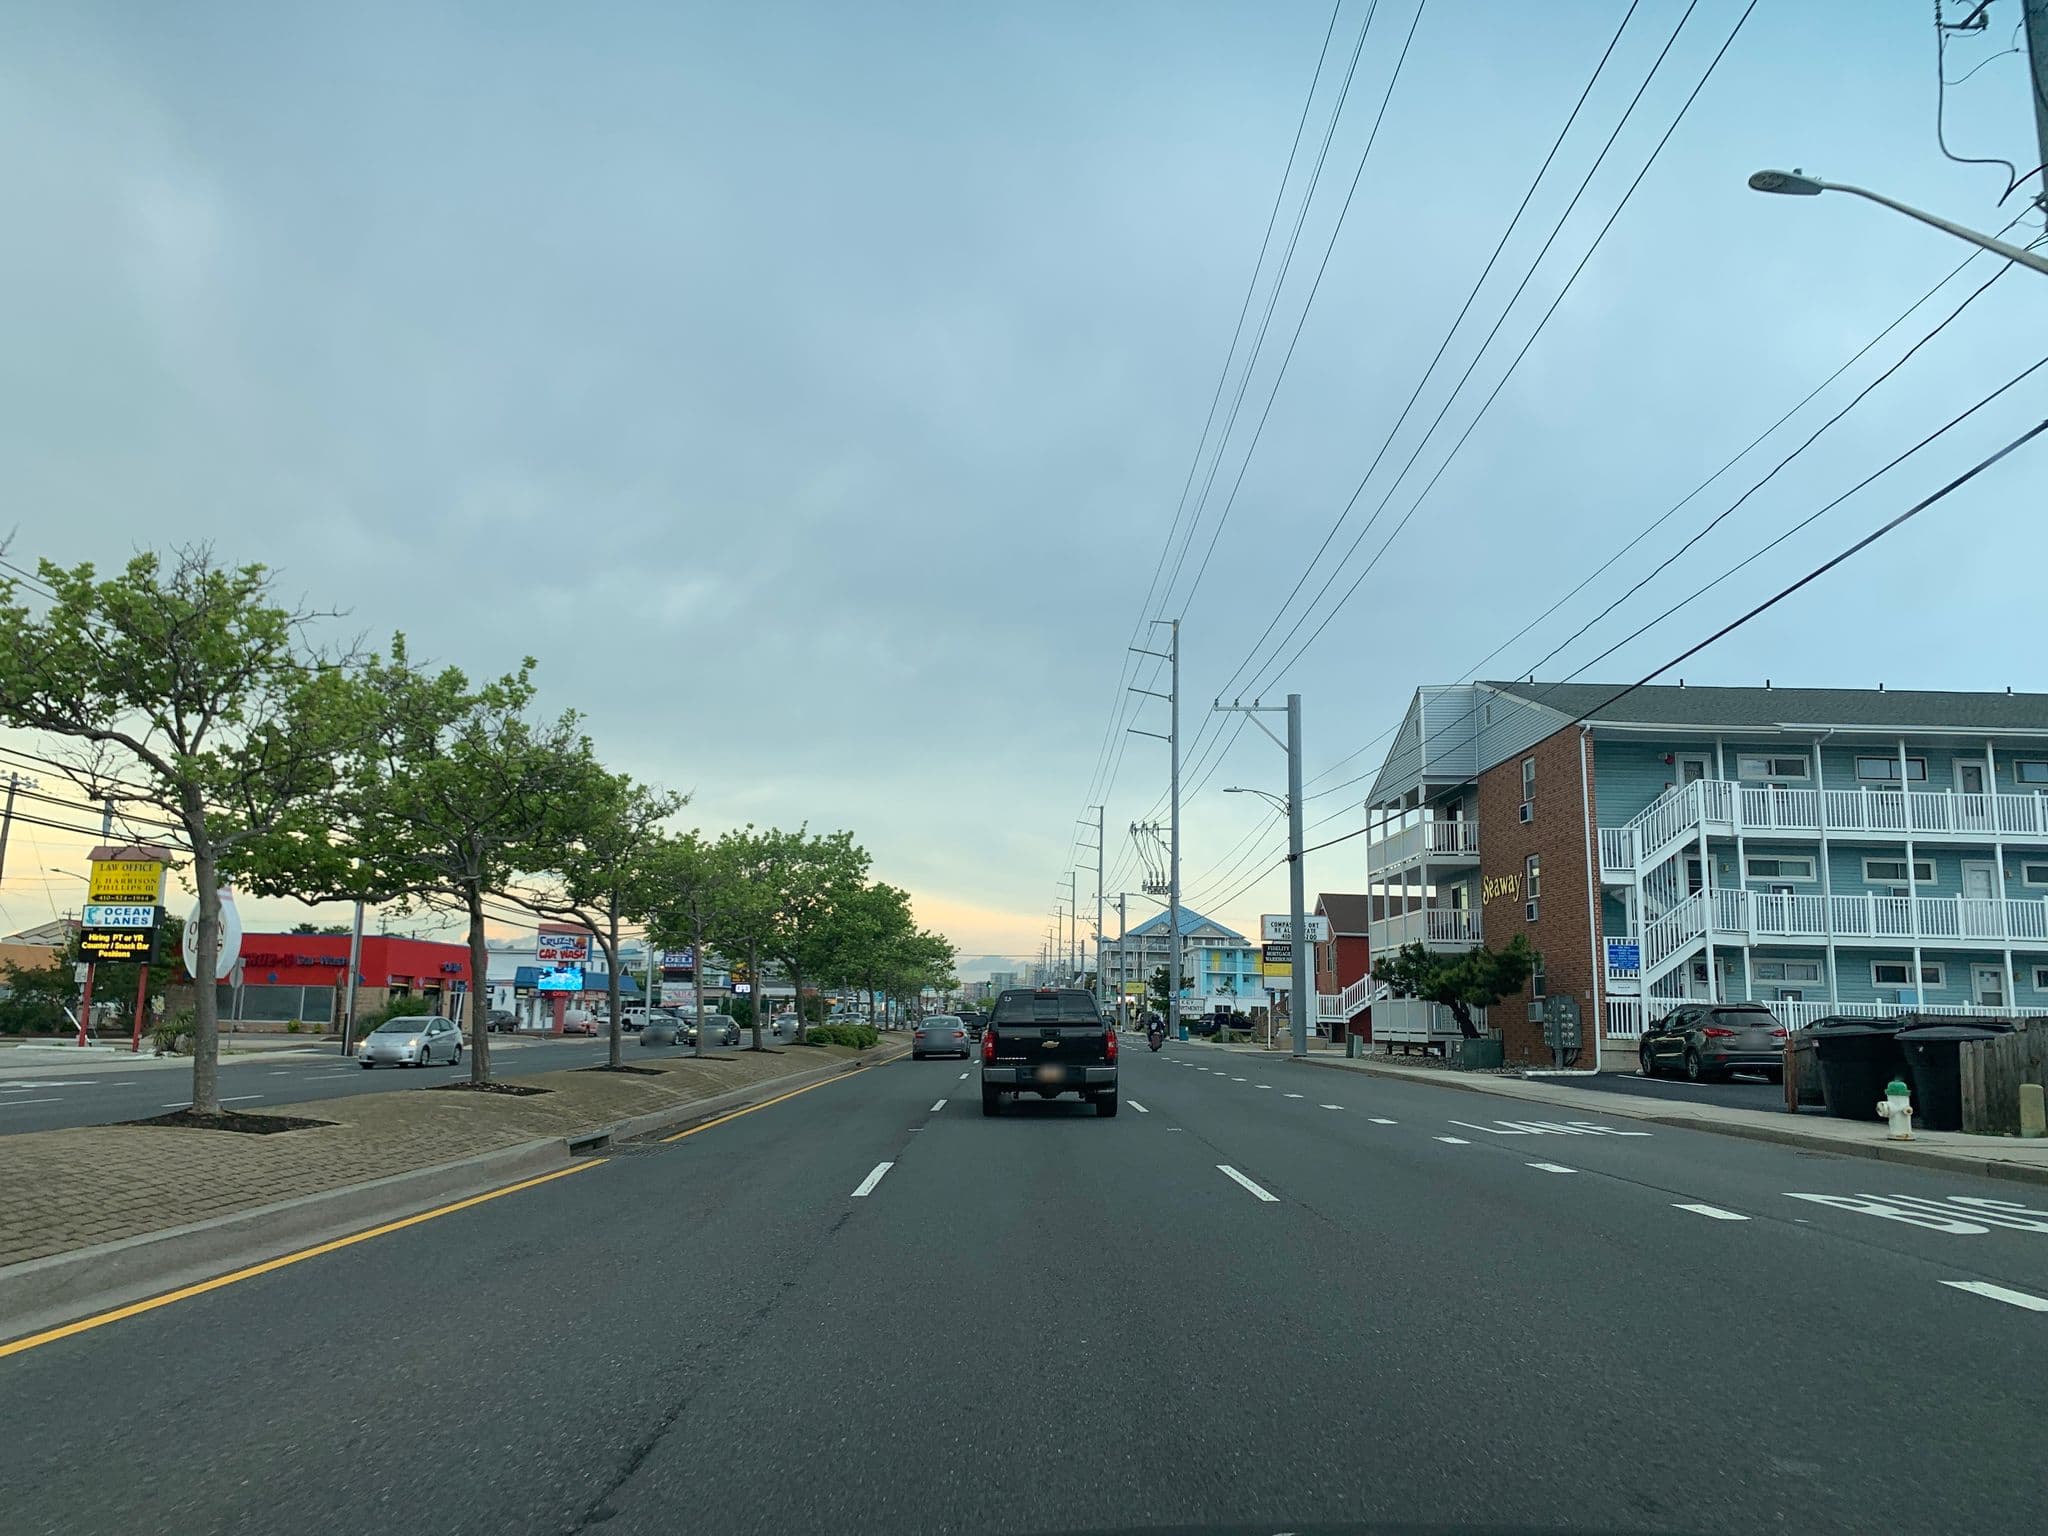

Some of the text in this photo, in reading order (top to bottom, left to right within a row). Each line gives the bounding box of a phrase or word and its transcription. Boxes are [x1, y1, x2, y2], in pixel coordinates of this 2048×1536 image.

[100, 863, 153, 872] LAW OFFICE
[1482, 871, 1523, 905] Seaway
[104, 907, 151, 916] OCEAN
[104, 916, 149, 925] LANES
[88, 934, 110, 942] Hiring
[112, 934, 123, 942] PT
[133, 934, 144, 942] YR
[540, 936, 576, 947] CRUZ-N
[114, 942, 136, 950] Snack
[98, 950, 131, 958] Positions
[539, 949, 586, 959] CAR WASH
[1448, 1120, 1654, 1136] LANE
